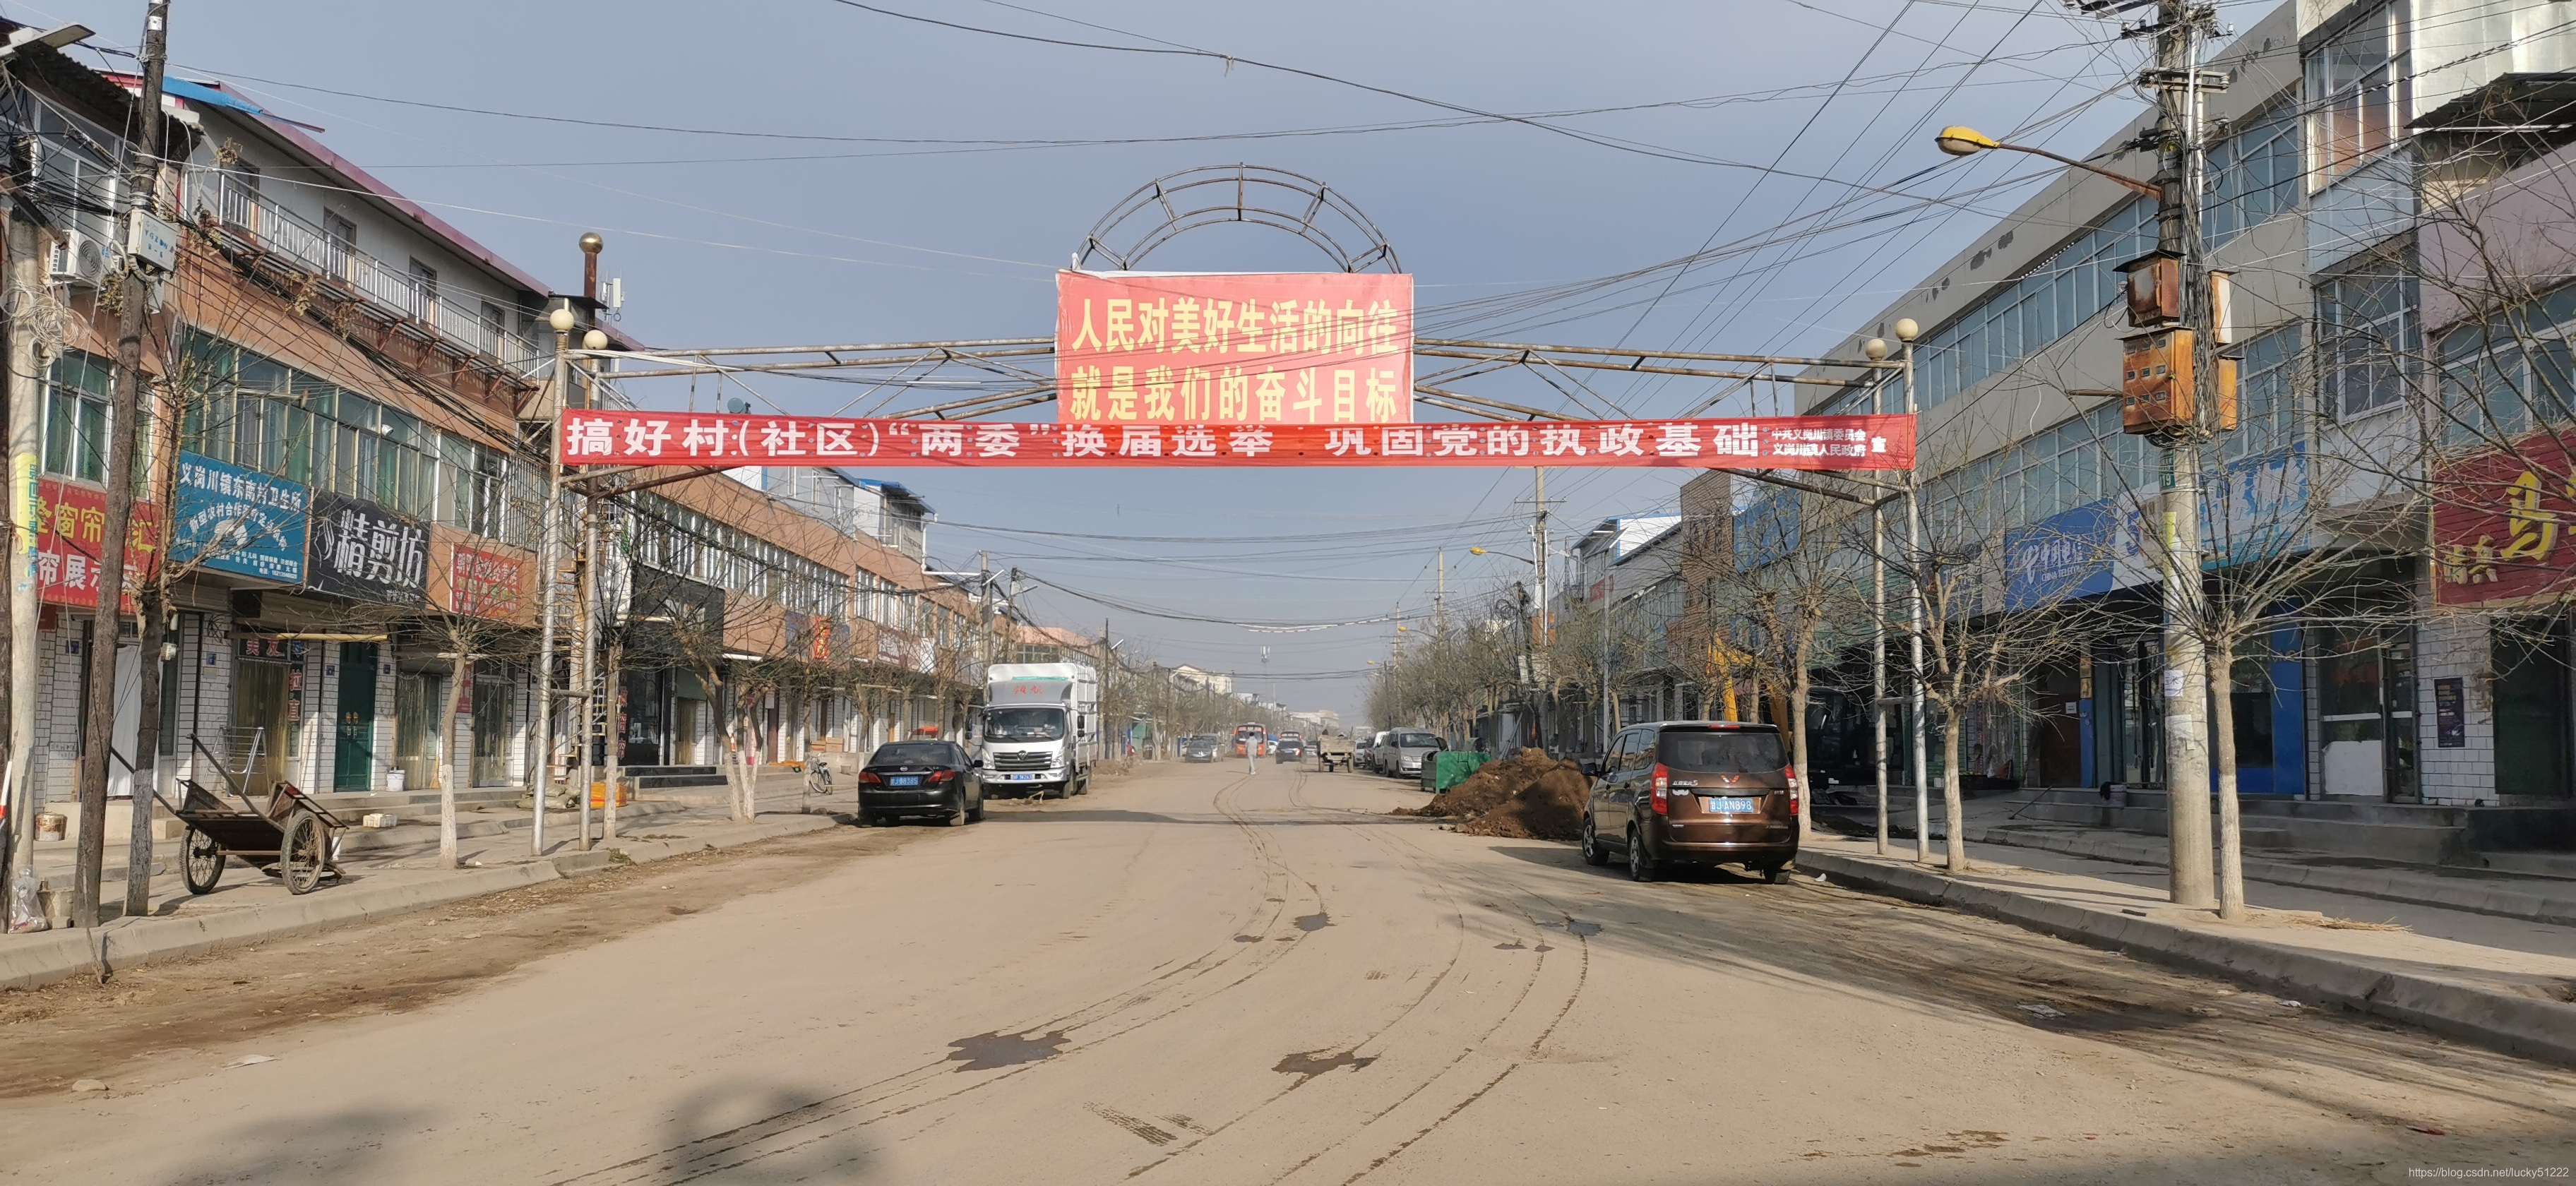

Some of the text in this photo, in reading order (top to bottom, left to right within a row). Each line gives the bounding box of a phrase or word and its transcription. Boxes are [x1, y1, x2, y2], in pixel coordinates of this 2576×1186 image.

[1071, 297, 1399, 354] 人民对美好生活的向往
[1070, 365, 1397, 424] 就是我们的奋斗目标
[1324, 421, 1758, 457] 巩固党的执政基础
[1772, 442, 1866, 457] 义岗川镇人民政府
[1871, 436, 1887, 453] 宣
[179, 462, 302, 513] 义岗川镇东南村卫生所
[333, 508, 426, 589] 精剪坊
[2443, 534, 2498, 585] 清真
